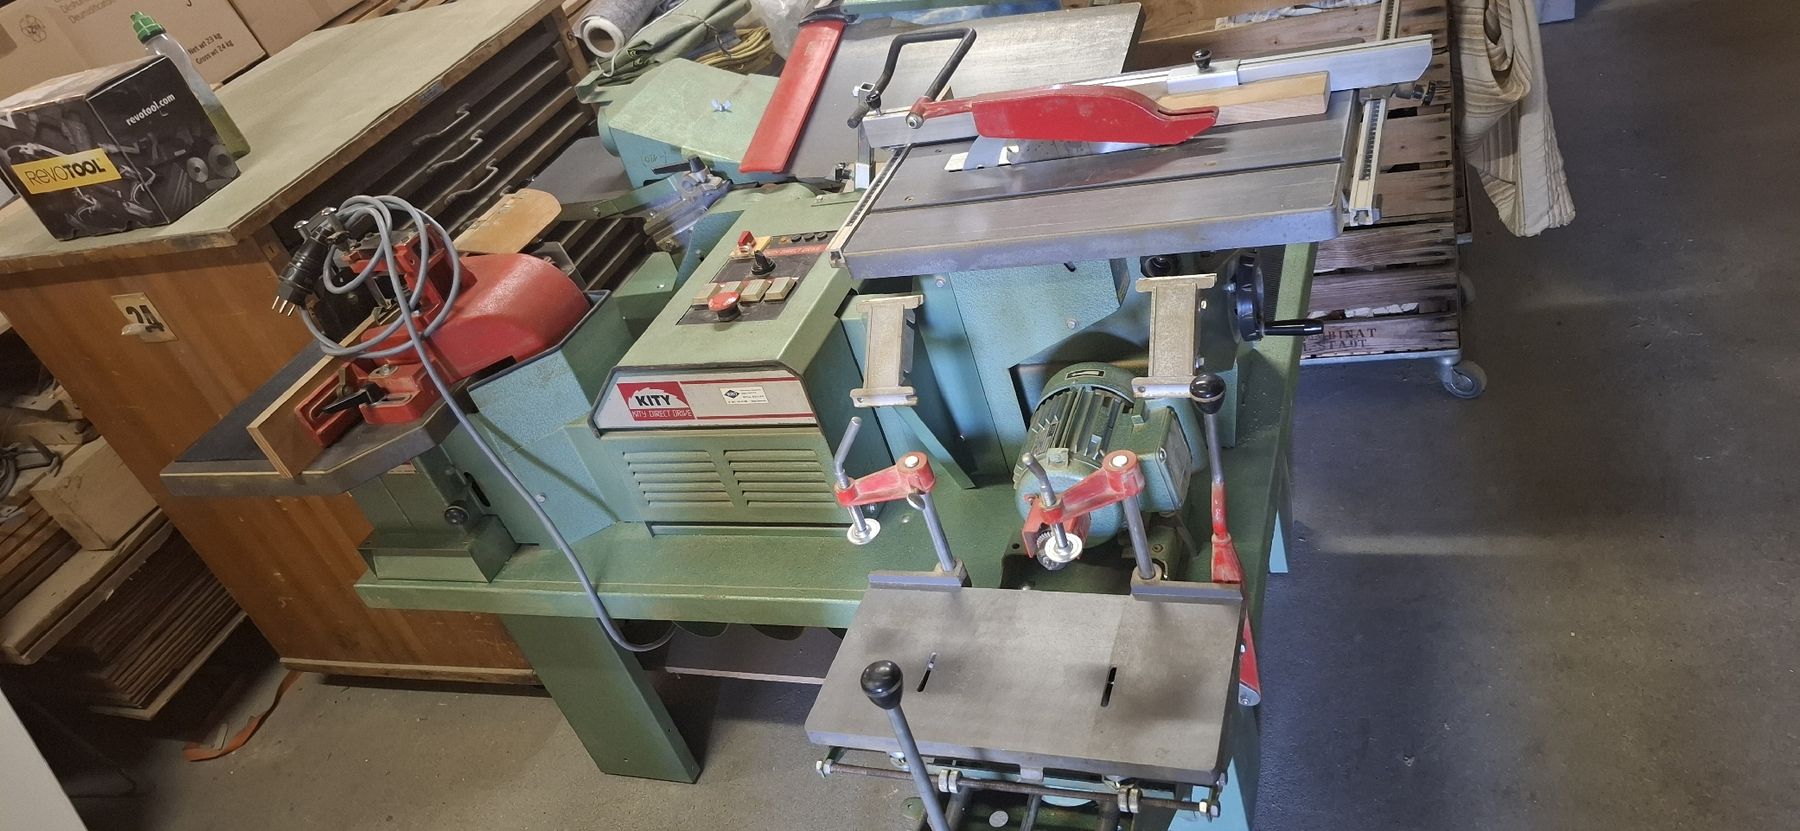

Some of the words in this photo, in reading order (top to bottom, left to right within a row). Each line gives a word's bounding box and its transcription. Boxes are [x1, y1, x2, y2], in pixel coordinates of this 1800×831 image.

[187, 46, 199, 55] Net
[205, 36, 215, 44] 23
[213, 33, 223, 41] kg
[195, 52, 212, 64] Gross
[211, 48, 219, 56] wt
[126, 93, 176, 126] revotool.com
[635, 394, 671, 407] KITY
[673, 409, 692, 417] DRIVE
